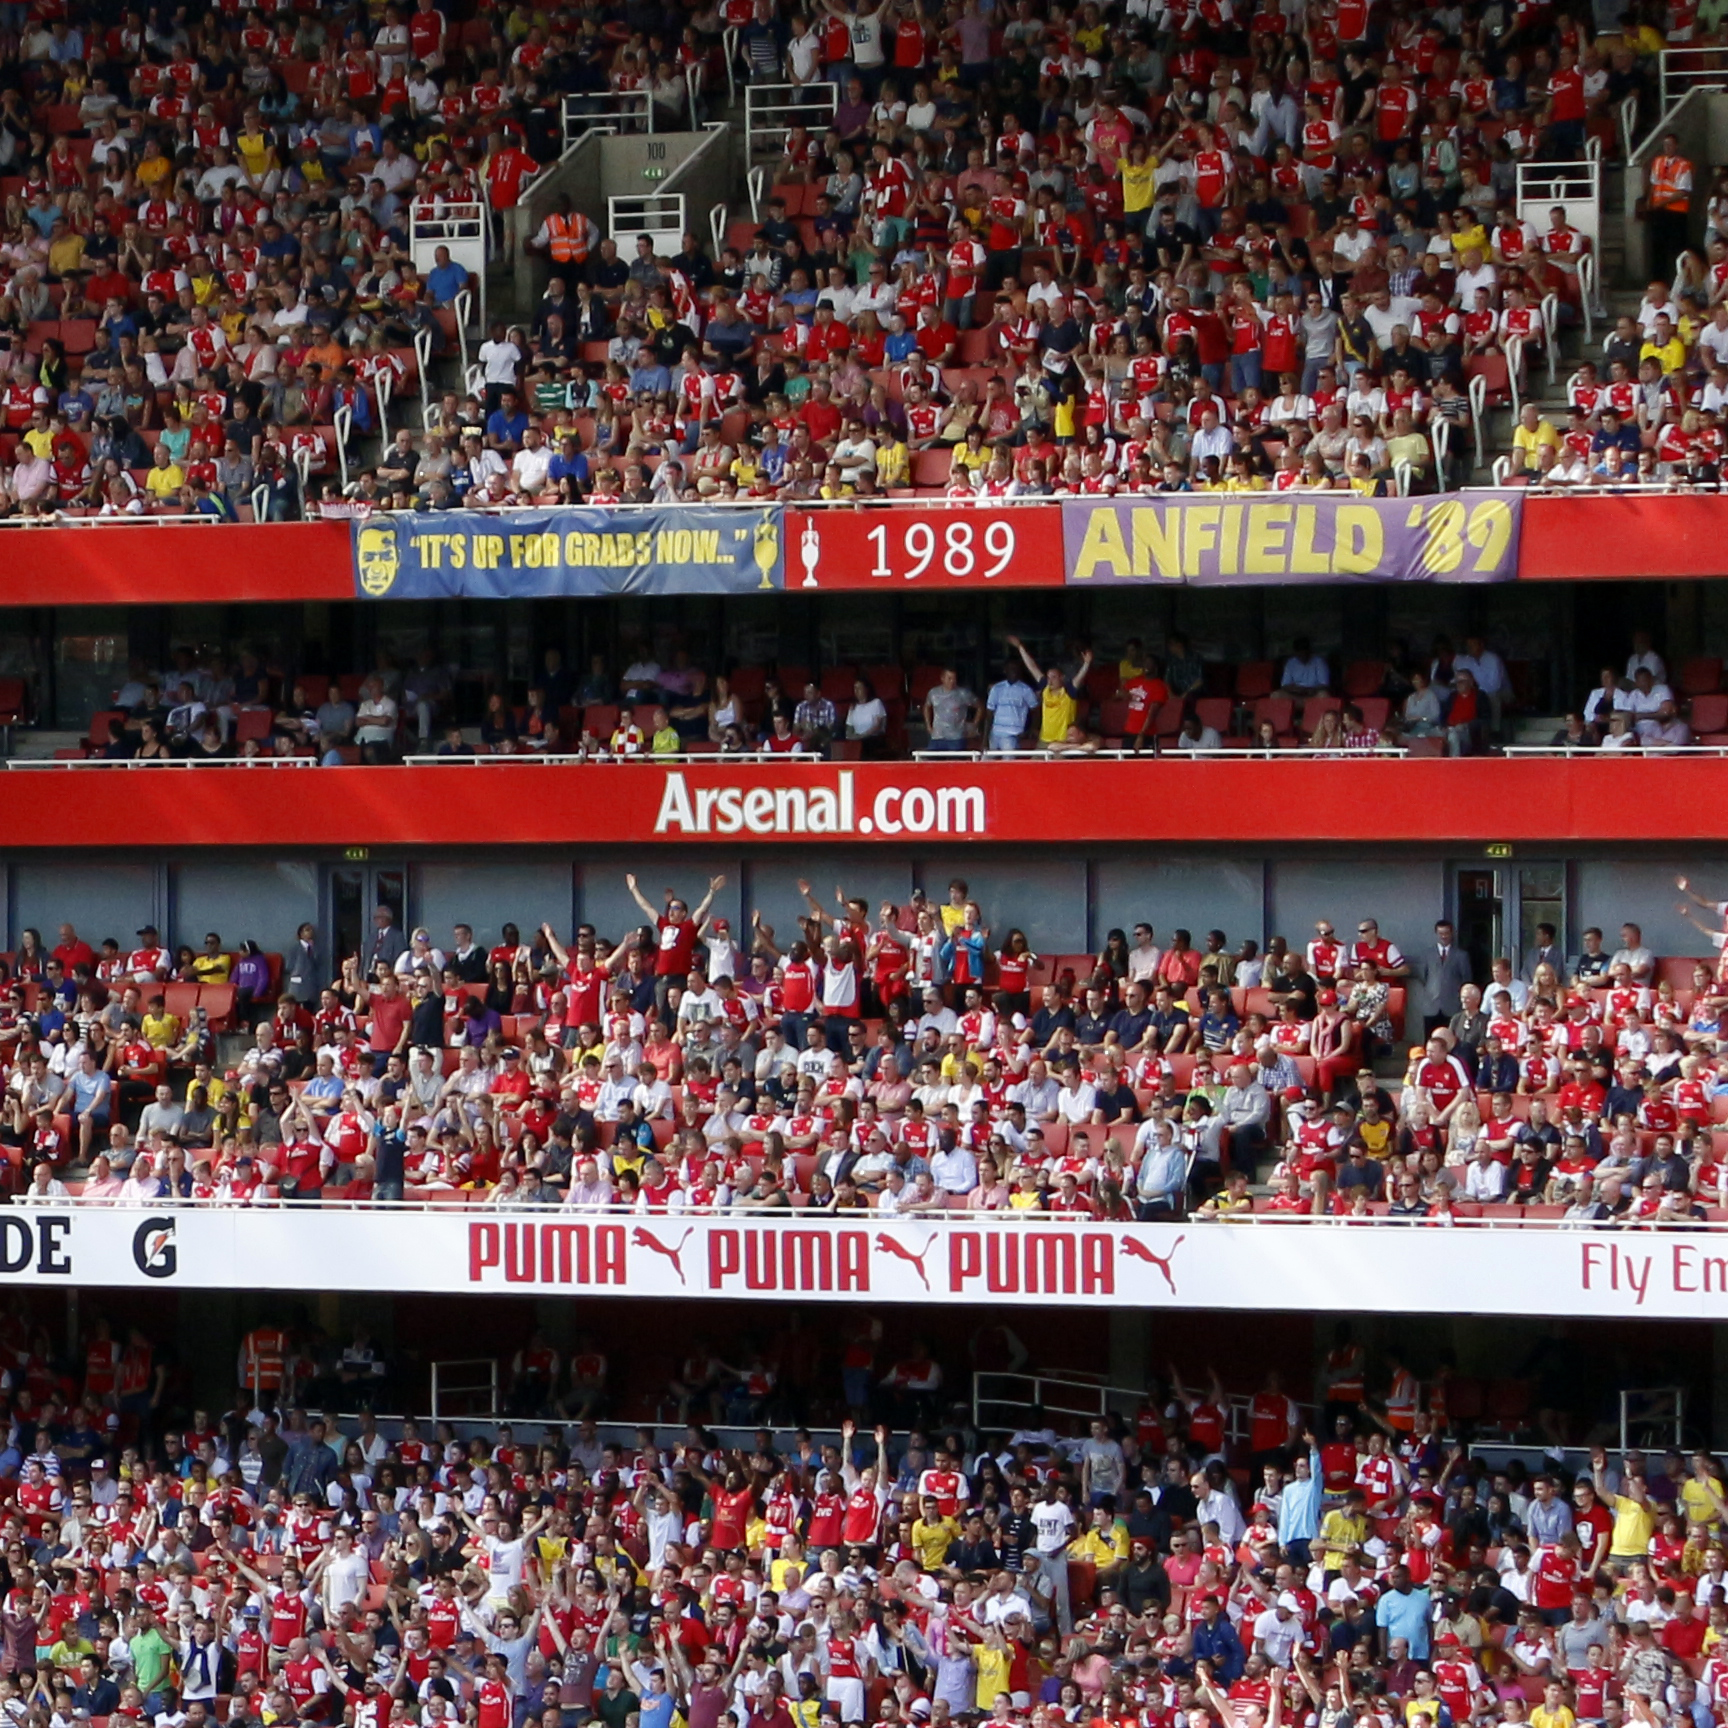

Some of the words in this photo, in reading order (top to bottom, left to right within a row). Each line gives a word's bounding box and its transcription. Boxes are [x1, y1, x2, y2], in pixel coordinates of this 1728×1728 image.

[647, 142, 666, 160] 100
[472, 533, 505, 569] UP
[510, 529, 560, 569] FOR
[564, 528, 651, 568] GRABS
[867, 519, 1016, 579] 1989
[1073, 502, 1385, 579] ANFIELD
[1406, 497, 1515, 574] '89
[653, 769, 987, 835] Arsenal.com
[132, 1216, 176, 1278] G
[468, 1222, 627, 1284] PUMA
[708, 1228, 870, 1292] PUMA
[949, 1231, 1115, 1296] PUMA
[1581, 1242, 1653, 1305] Fly
